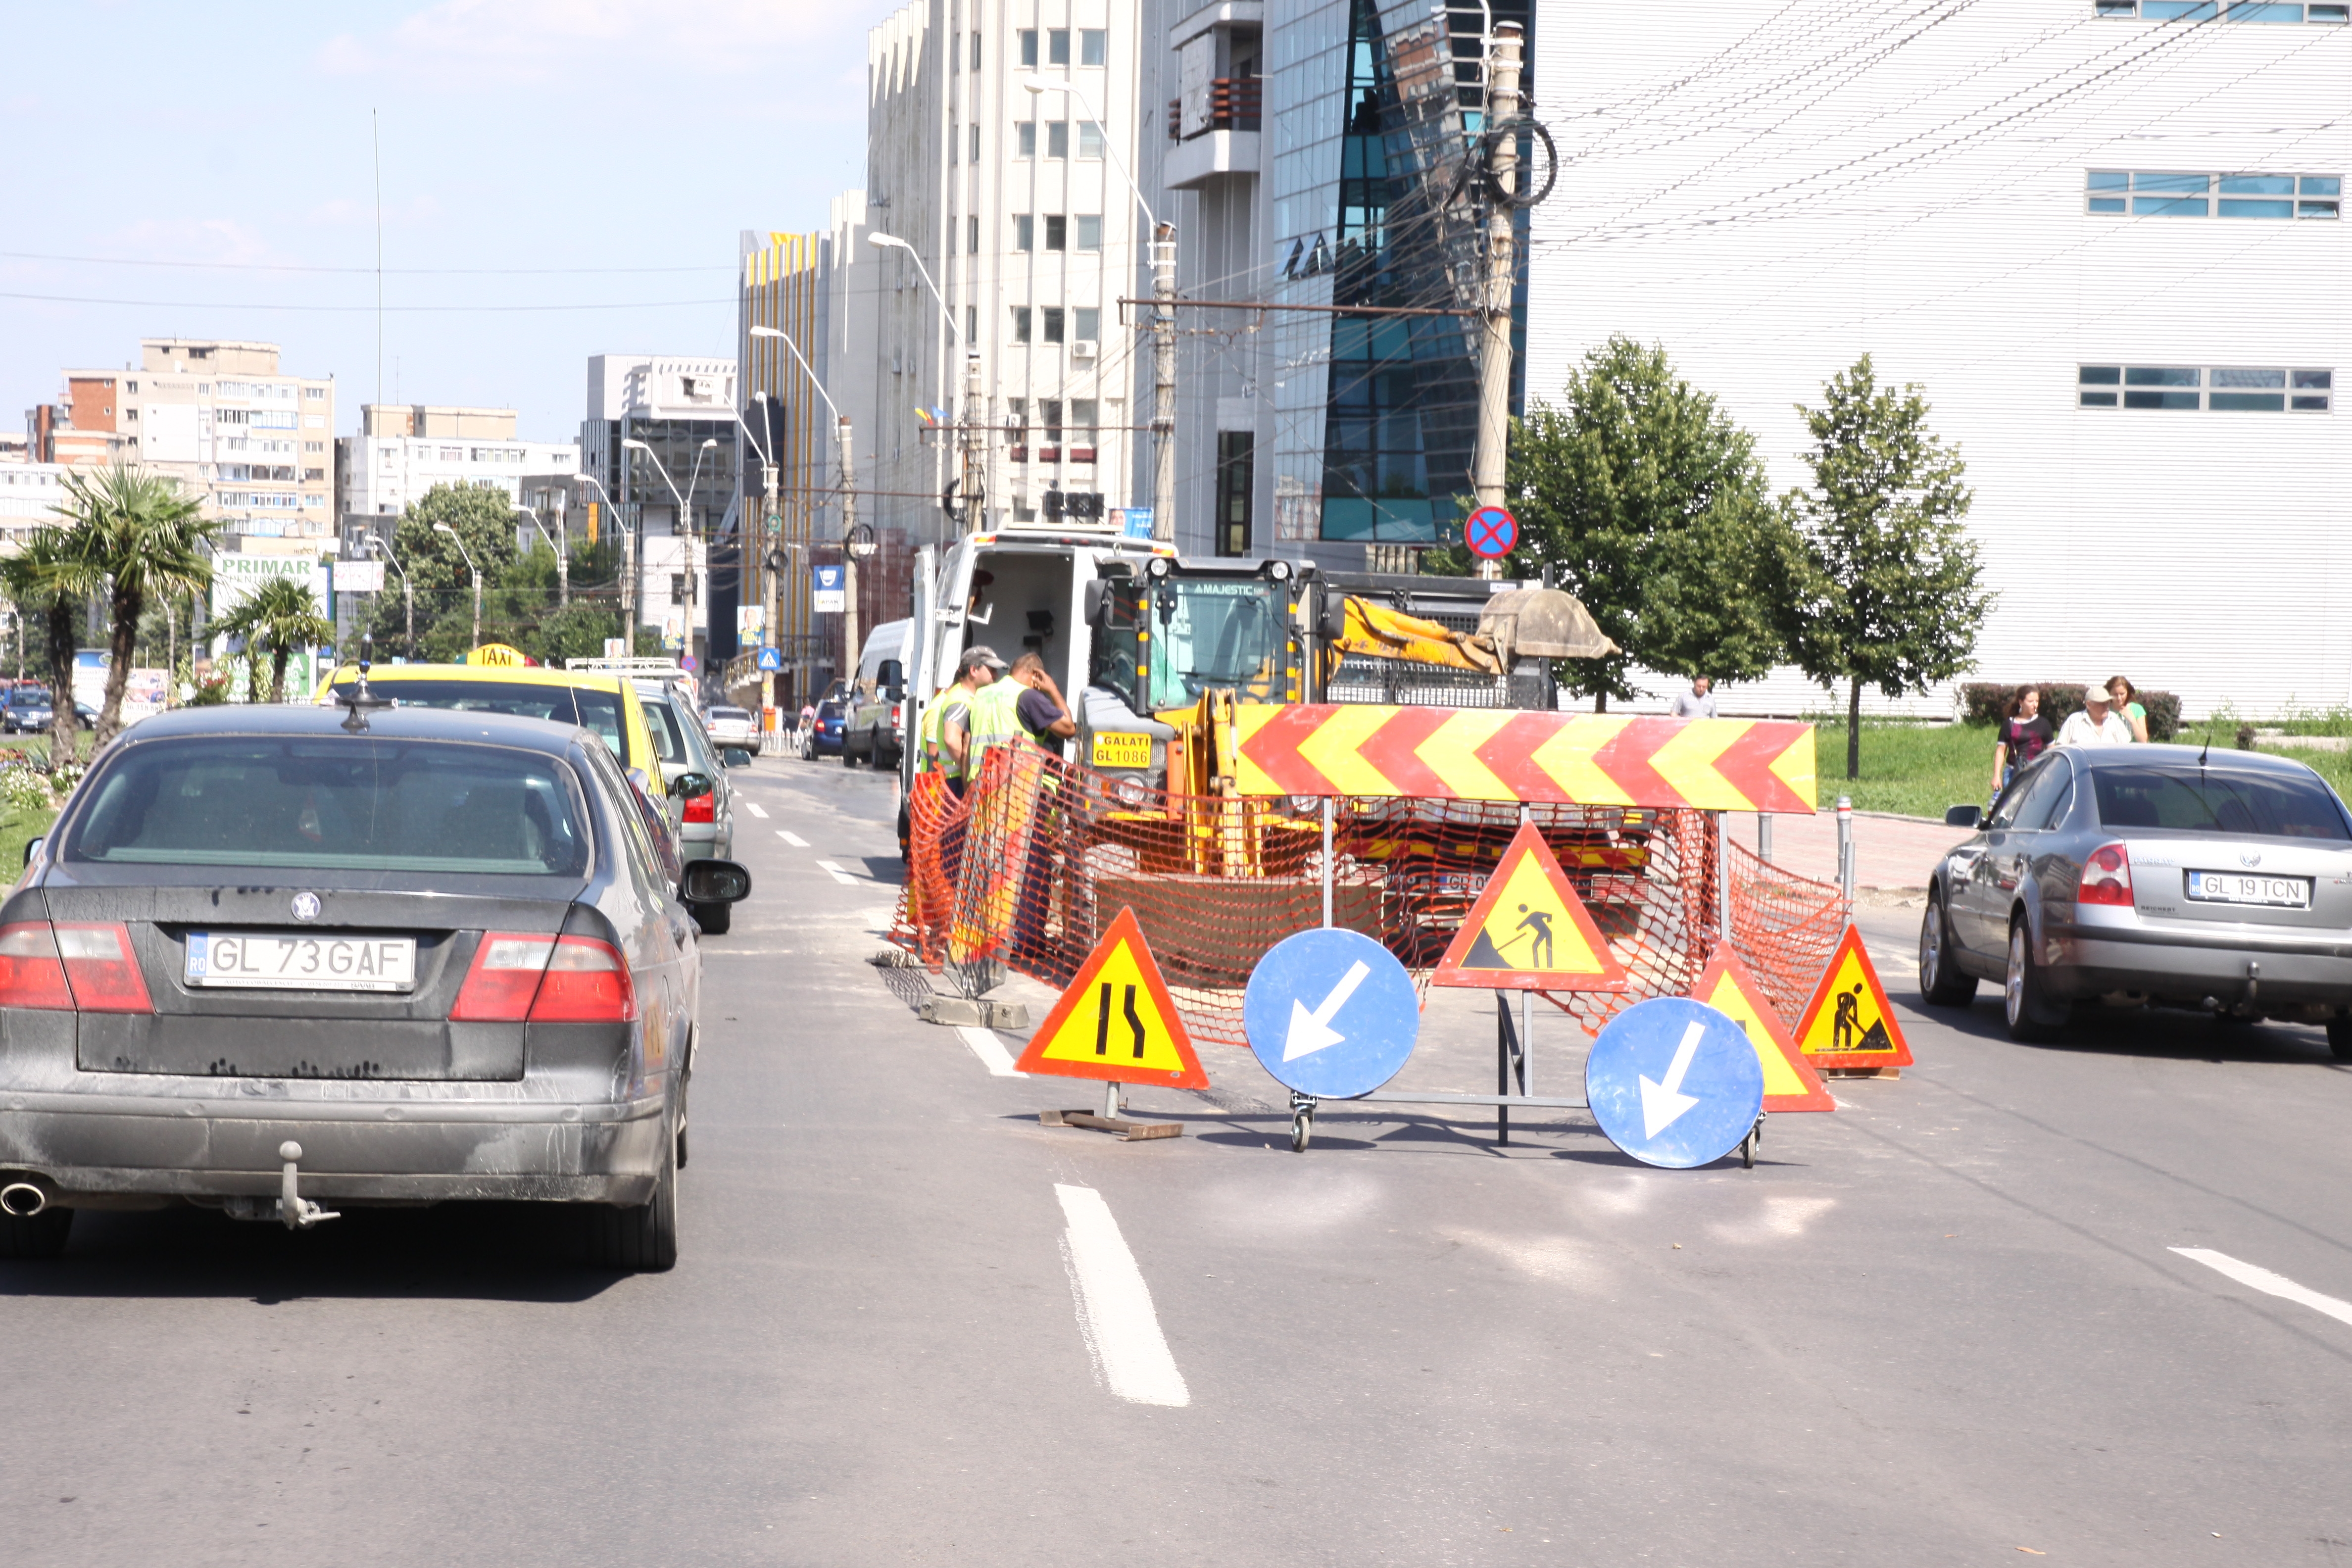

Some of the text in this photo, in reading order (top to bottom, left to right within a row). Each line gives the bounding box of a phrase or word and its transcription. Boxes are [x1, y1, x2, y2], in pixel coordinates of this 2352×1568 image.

[222, 559, 311, 575] PRIMAR
[1203, 584, 1253, 595] MAJESTIC
[481, 647, 511, 666] TAXI
[1104, 736, 1149, 746] GALATI
[1096, 750, 1147, 763] GL 1086
[2191, 876, 2300, 899] RO GL 19 TCN
[190, 956, 206, 972] RO
[212, 937, 260, 973] GL
